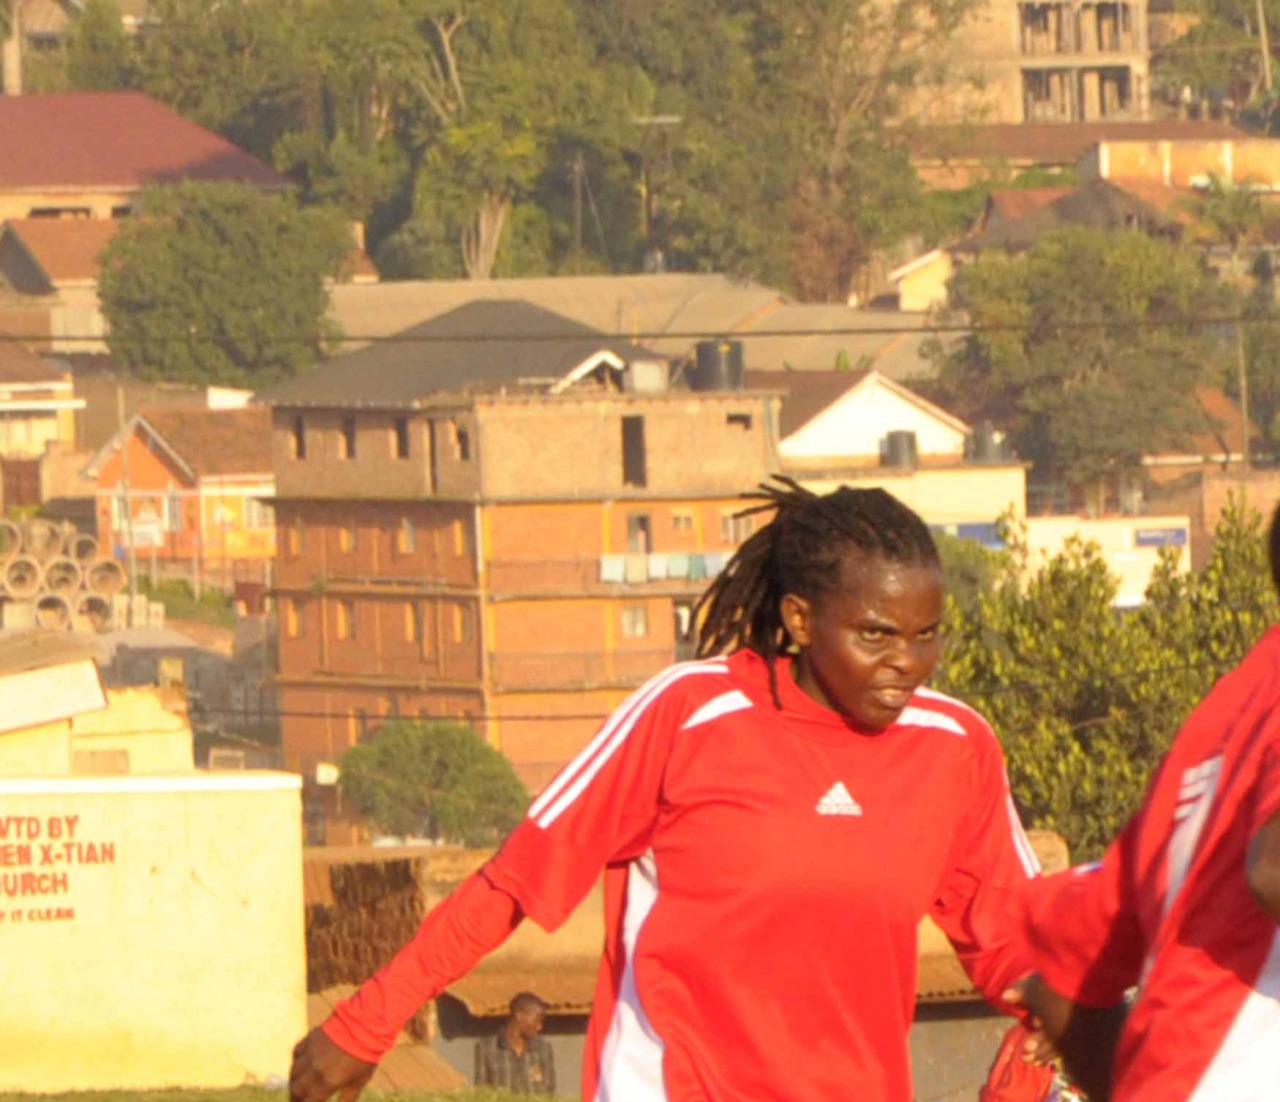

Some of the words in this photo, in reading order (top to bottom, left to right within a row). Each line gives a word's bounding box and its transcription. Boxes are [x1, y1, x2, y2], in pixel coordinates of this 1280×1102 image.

[47, 814, 79, 839] BY
[0, 843, 32, 867] EN
[40, 841, 115, 866] X-TIAN
[0, 871, 68, 897] URCH
